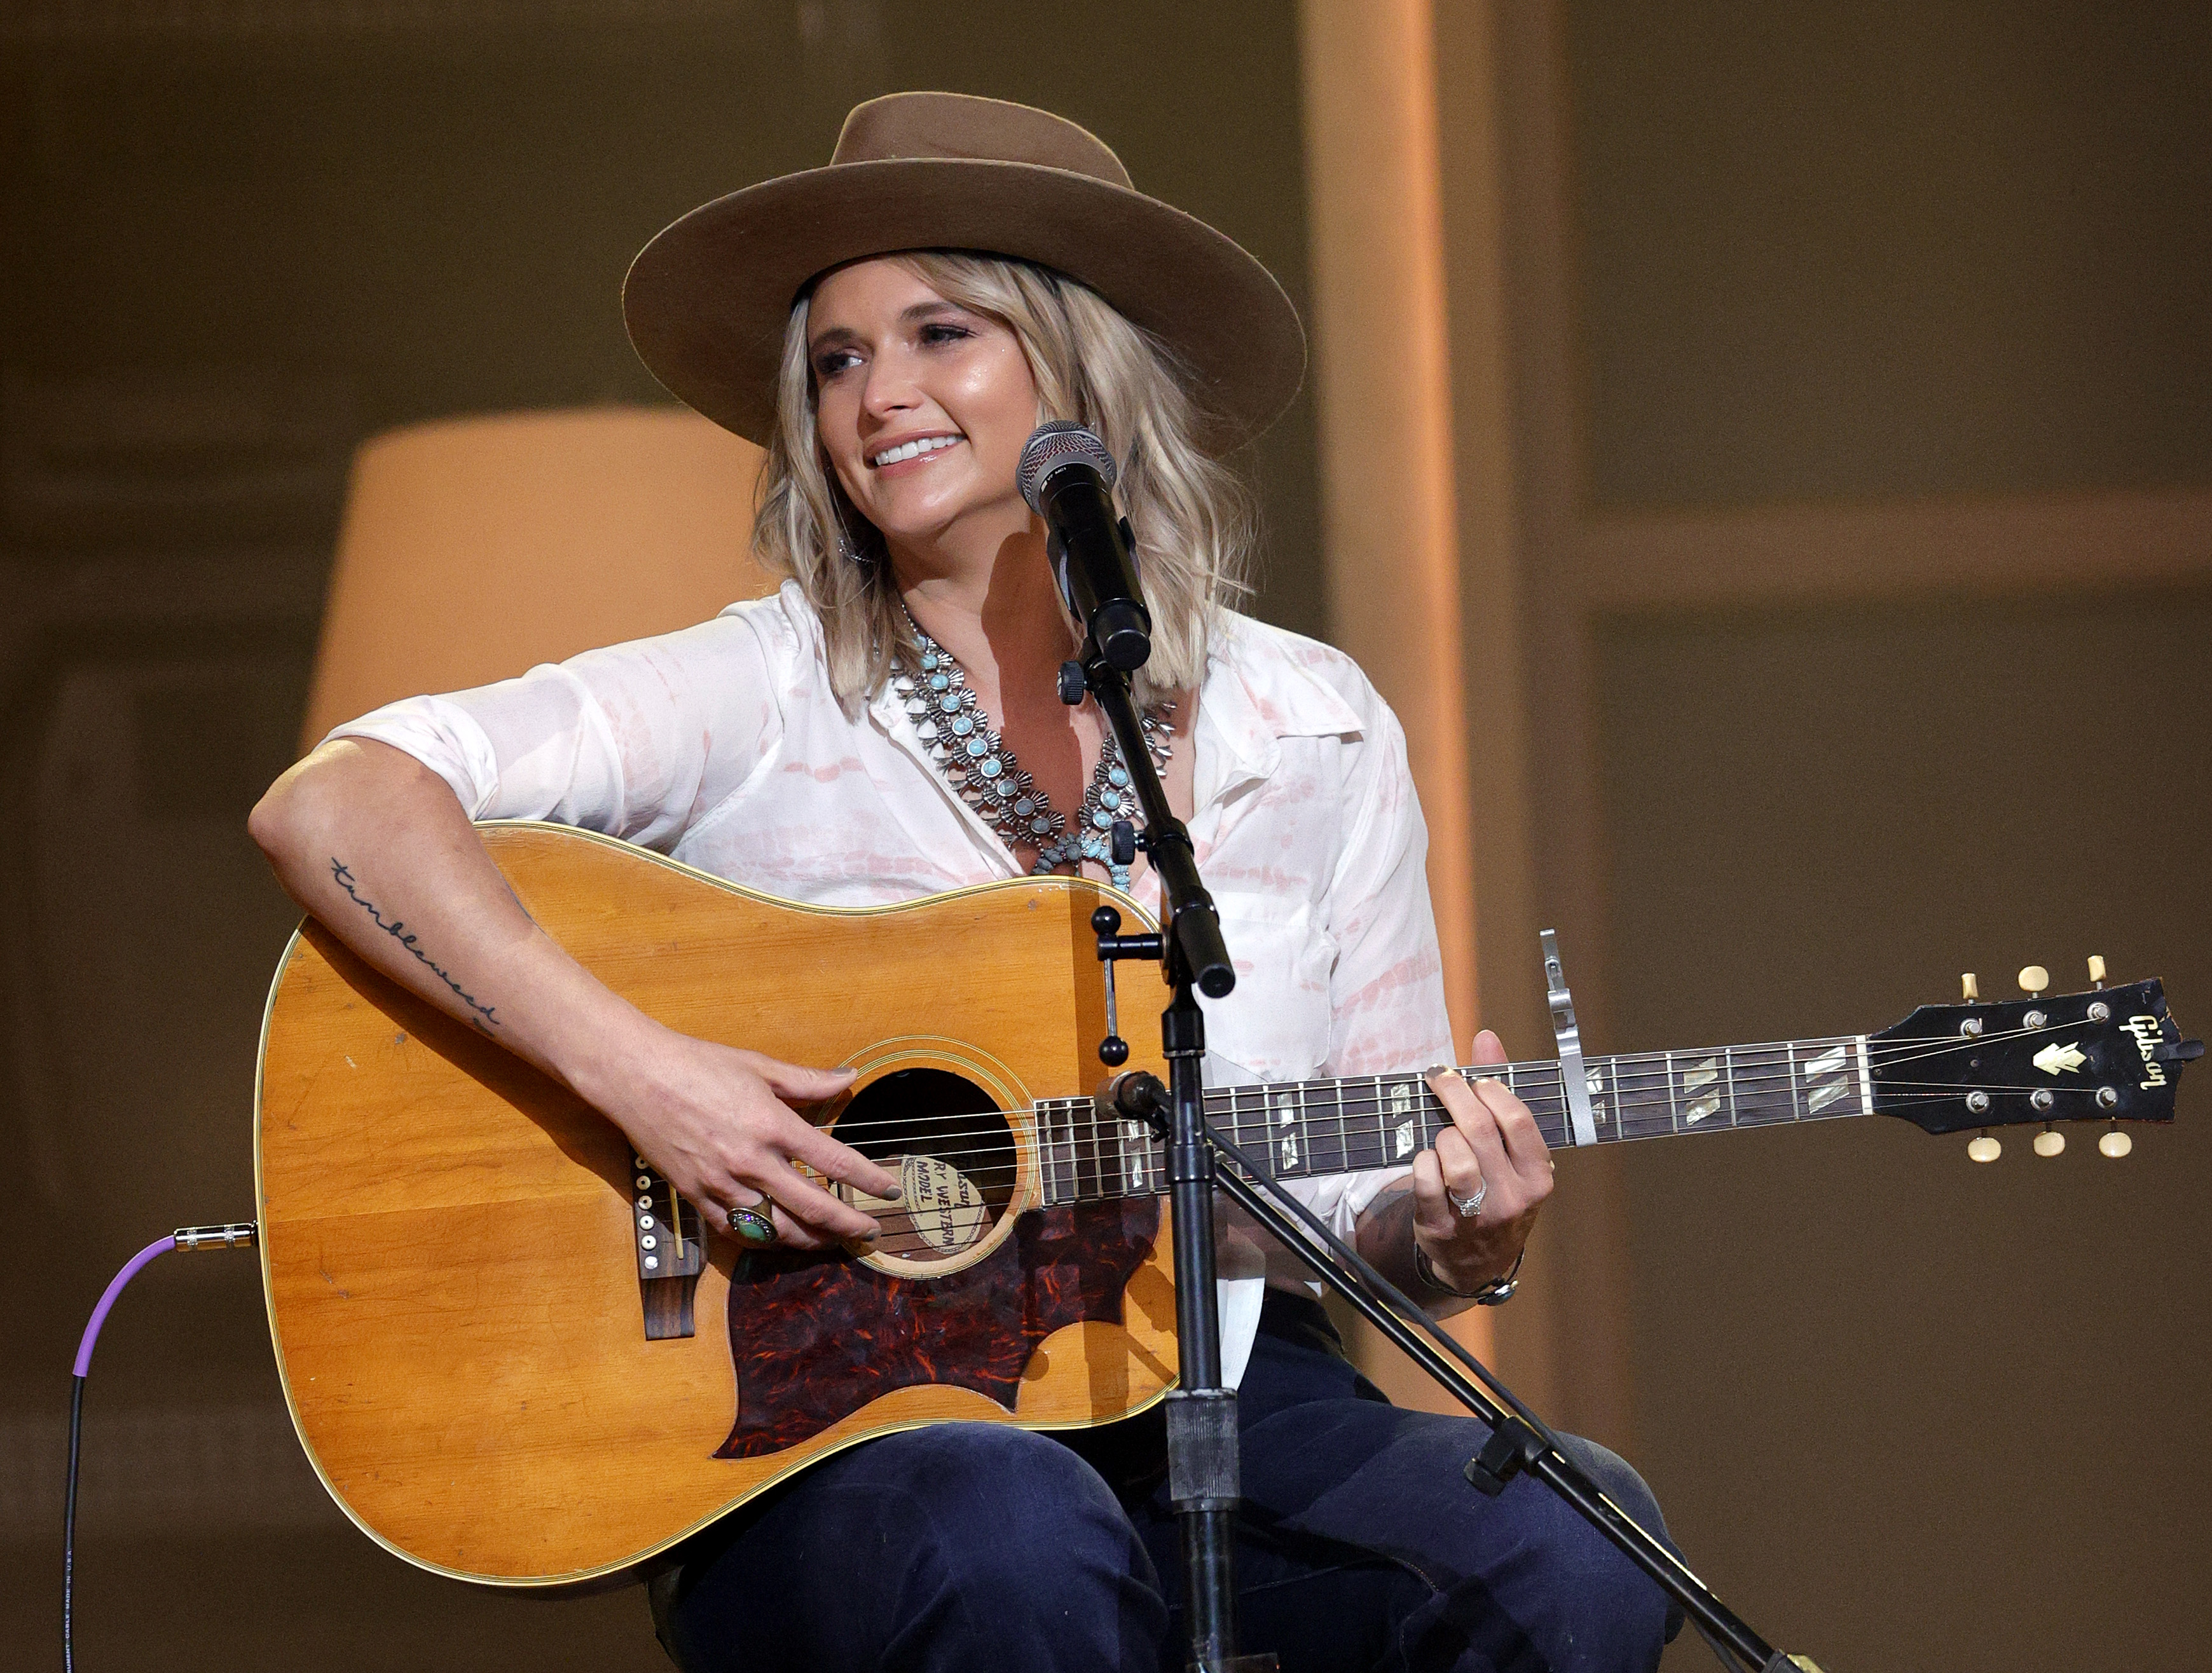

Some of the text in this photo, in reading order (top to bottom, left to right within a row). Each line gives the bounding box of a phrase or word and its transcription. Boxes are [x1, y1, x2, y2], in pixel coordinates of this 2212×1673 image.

[331, 857, 500, 1025] tumbleweed
[2119, 1014, 2167, 1091] Gibson
[916, 1160, 933, 1203] MODEL
[936, 1185, 955, 1246] WESTERN
